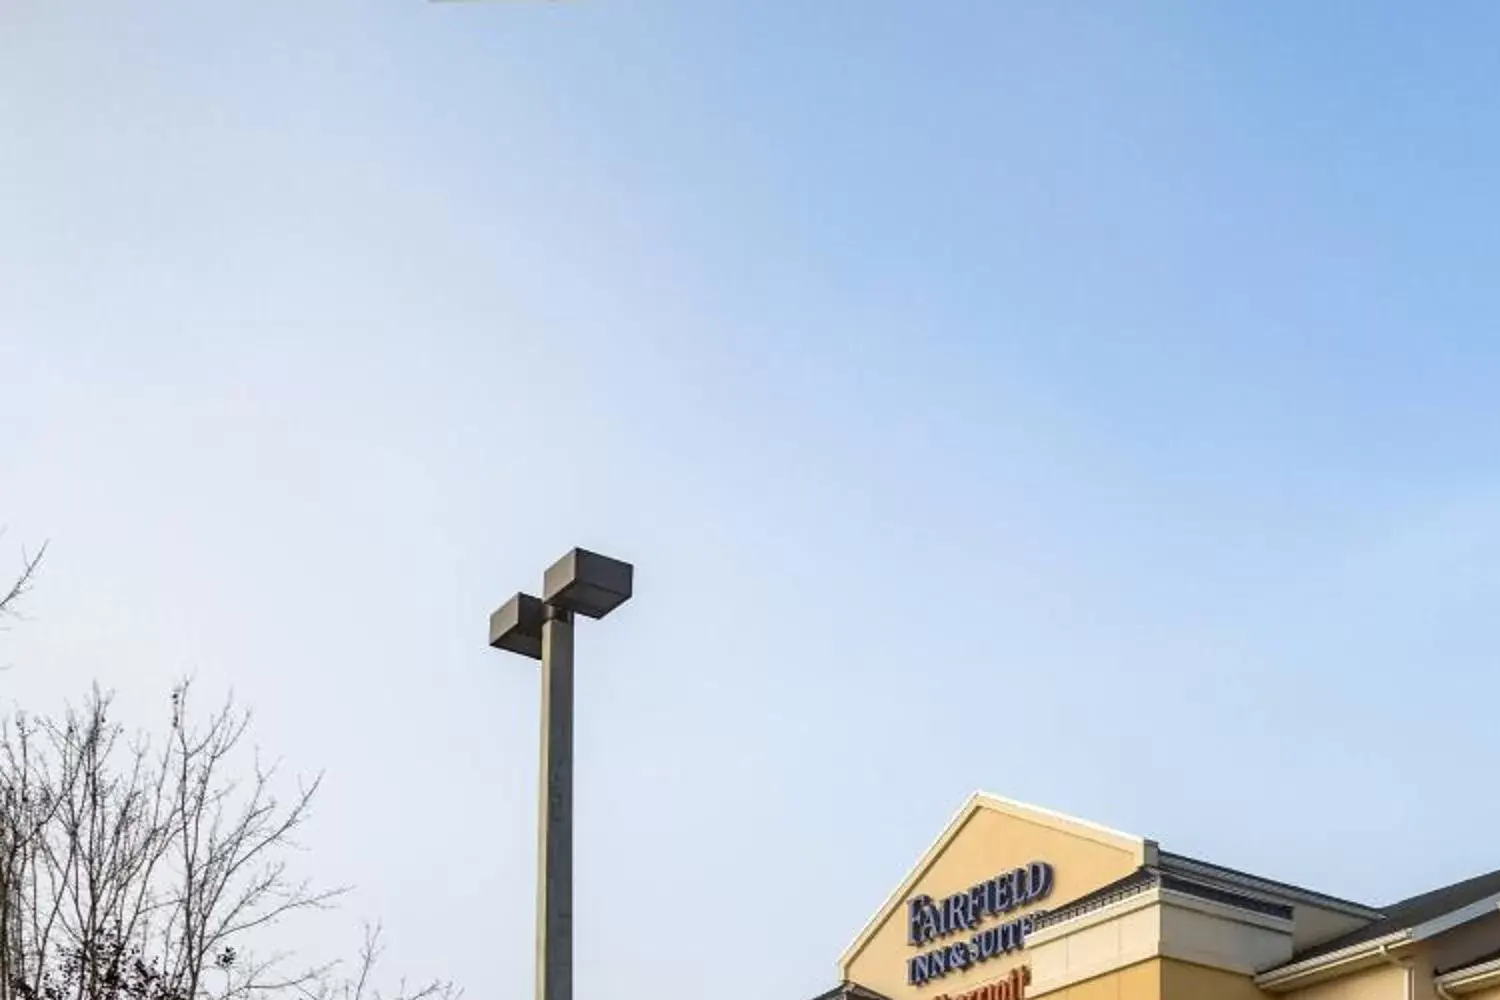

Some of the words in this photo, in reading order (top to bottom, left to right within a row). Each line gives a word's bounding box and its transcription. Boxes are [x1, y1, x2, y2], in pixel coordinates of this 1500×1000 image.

[907, 861, 1056, 947] FAIRFIELD
[906, 952, 951, 988] INN
[948, 941, 971, 974] &
